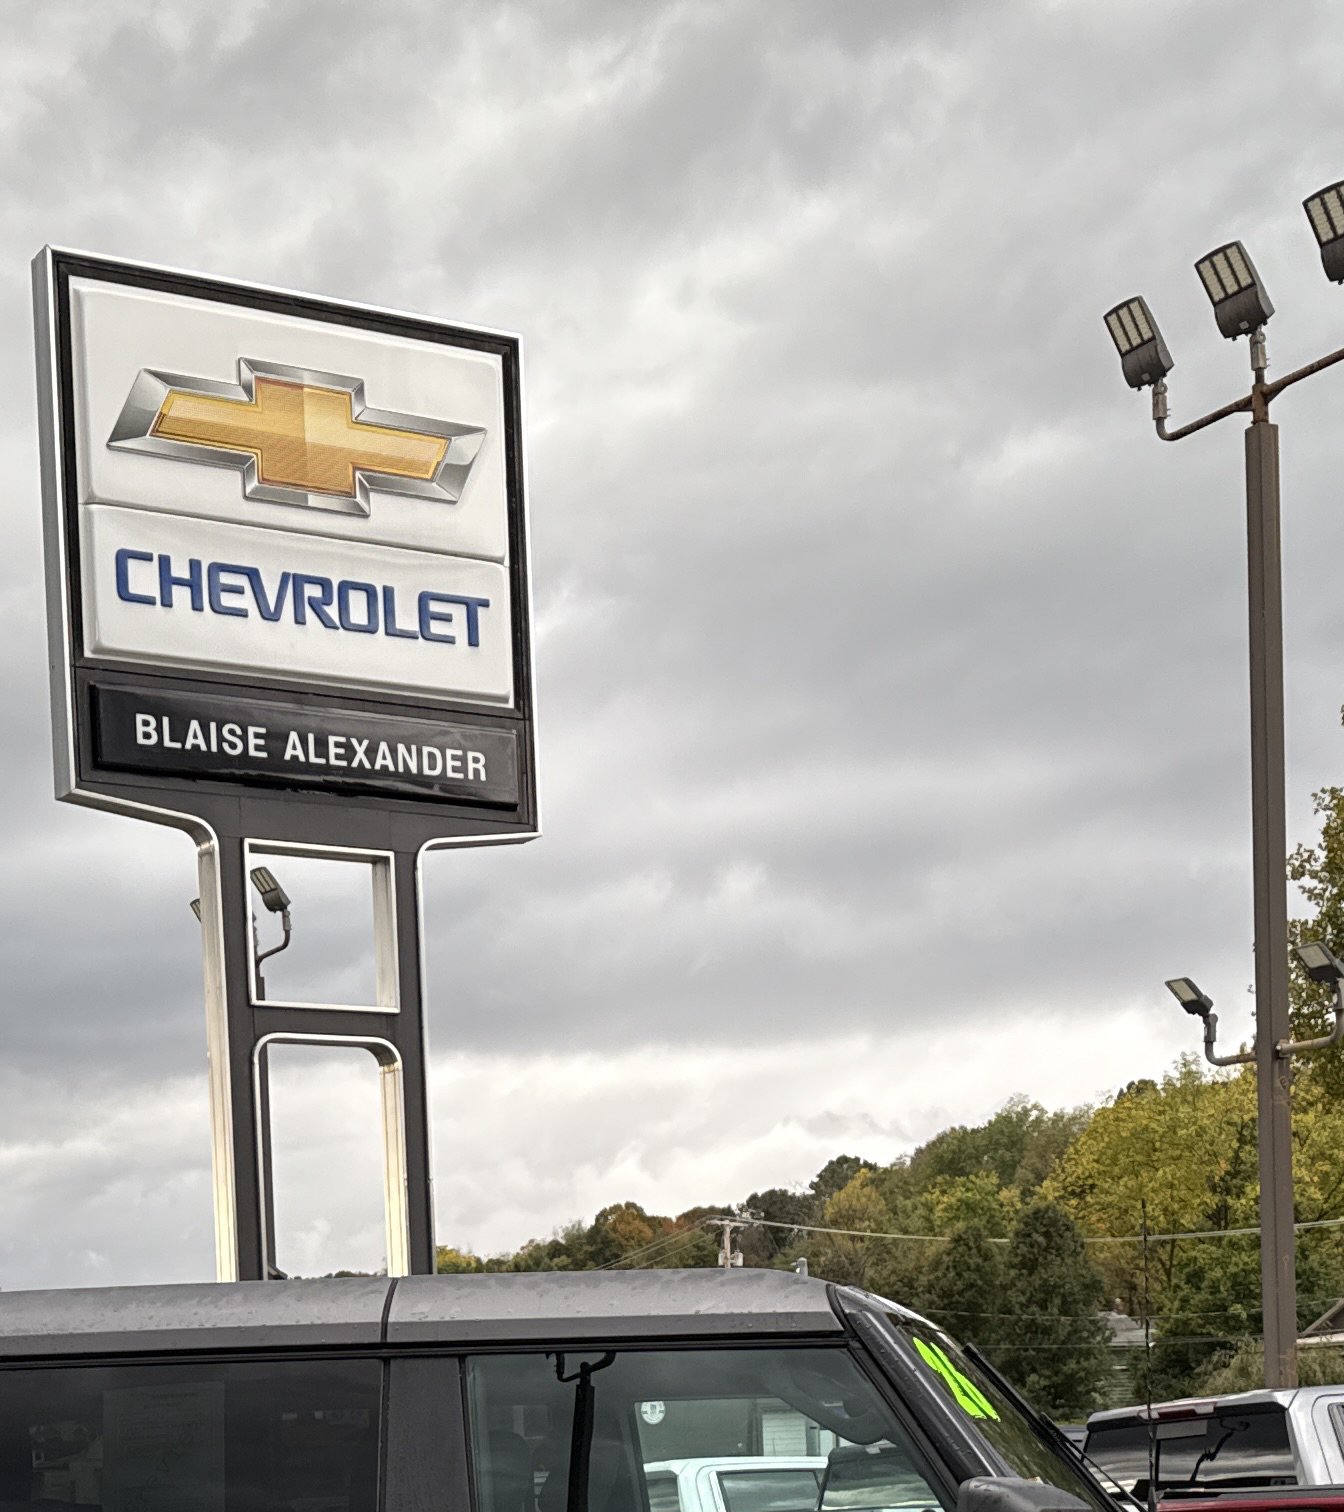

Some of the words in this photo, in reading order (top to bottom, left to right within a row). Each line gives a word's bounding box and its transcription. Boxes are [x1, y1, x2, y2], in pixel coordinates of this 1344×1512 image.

[113, 547, 491, 648] CHEVROLET
[134, 712, 269, 760] BLAISE
[284, 729, 489, 783] ALEXANDER
